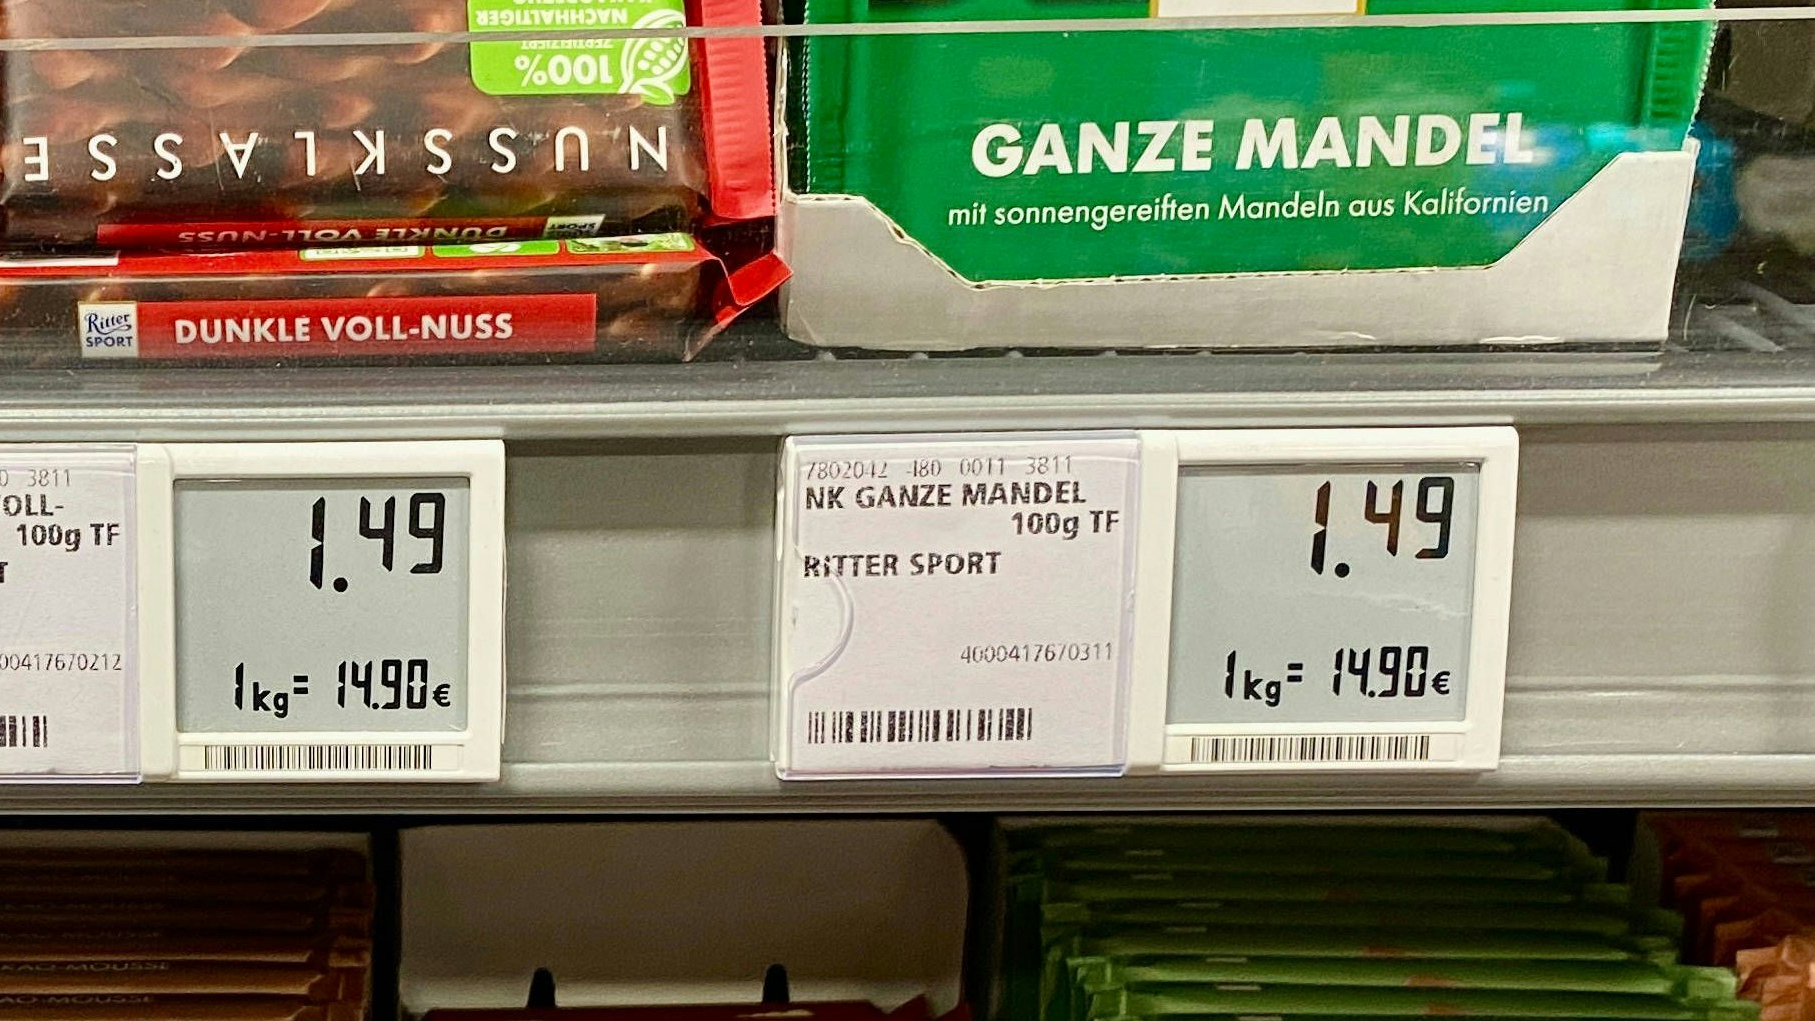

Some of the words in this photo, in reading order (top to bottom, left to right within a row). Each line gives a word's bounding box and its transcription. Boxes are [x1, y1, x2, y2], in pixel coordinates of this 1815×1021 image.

[476, 8, 627, 25] NACHHALTIGER
[514, 54, 613, 87] 100%
[972, 121, 1213, 177] GANZE
[1236, 113, 1534, 171] MANDEL
[948, 202, 986, 227] mit
[994, 194, 1209, 231] sonnengereiften
[1220, 192, 1339, 221] Mandeln
[1348, 194, 1395, 218] aus
[1404, 189, 1549, 218] Kalifornien
[85, 312, 131, 333] Ritter
[176, 317, 310, 344] DUNKLE
[322, 313, 513, 341] VOLL-NUSS
[86, 336, 133, 347] SPORT
[805, 486, 845, 510] NK
[855, 484, 953, 509] GANZE
[961, 481, 1086, 505] MANDEL
[17, 524, 81, 551] 100g
[90, 523, 120, 546] TF
[1011, 511, 1079, 539] 100g
[1089, 510, 1119, 533] TF
[1310, 476, 1455, 578] 1.49
[309, 492, 445, 592] 1.49
[804, 552, 898, 578] RITTER
[910, 550, 1001, 576] SPORT
[338, 659, 451, 710] 14.90€
[1332, 645, 1451, 698] 14.90€
